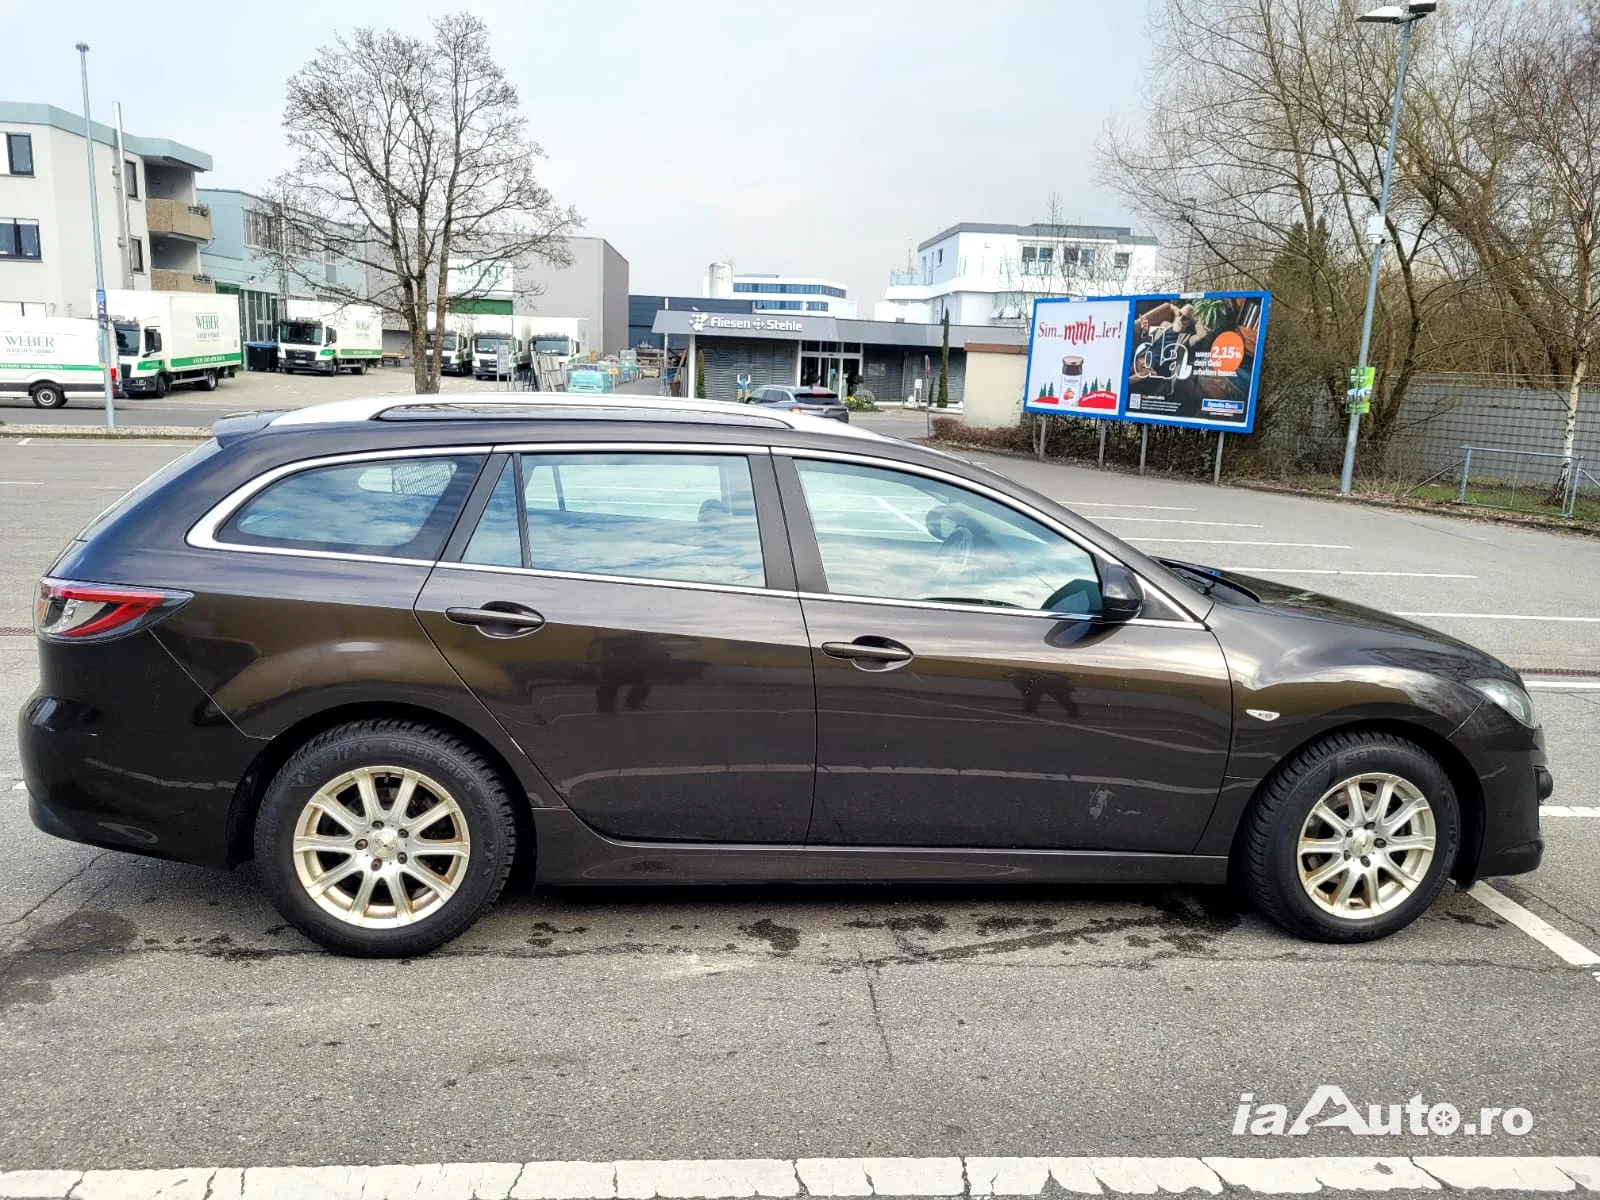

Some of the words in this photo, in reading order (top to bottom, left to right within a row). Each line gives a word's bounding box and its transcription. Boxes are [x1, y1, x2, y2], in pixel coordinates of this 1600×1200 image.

[195, 315, 219, 329] WEBER
[711, 316, 750, 329] Fliesen
[766, 319, 803, 331] Stehle
[5, 335, 55, 348] WEBER
[1194, 358, 1207, 367] dein
